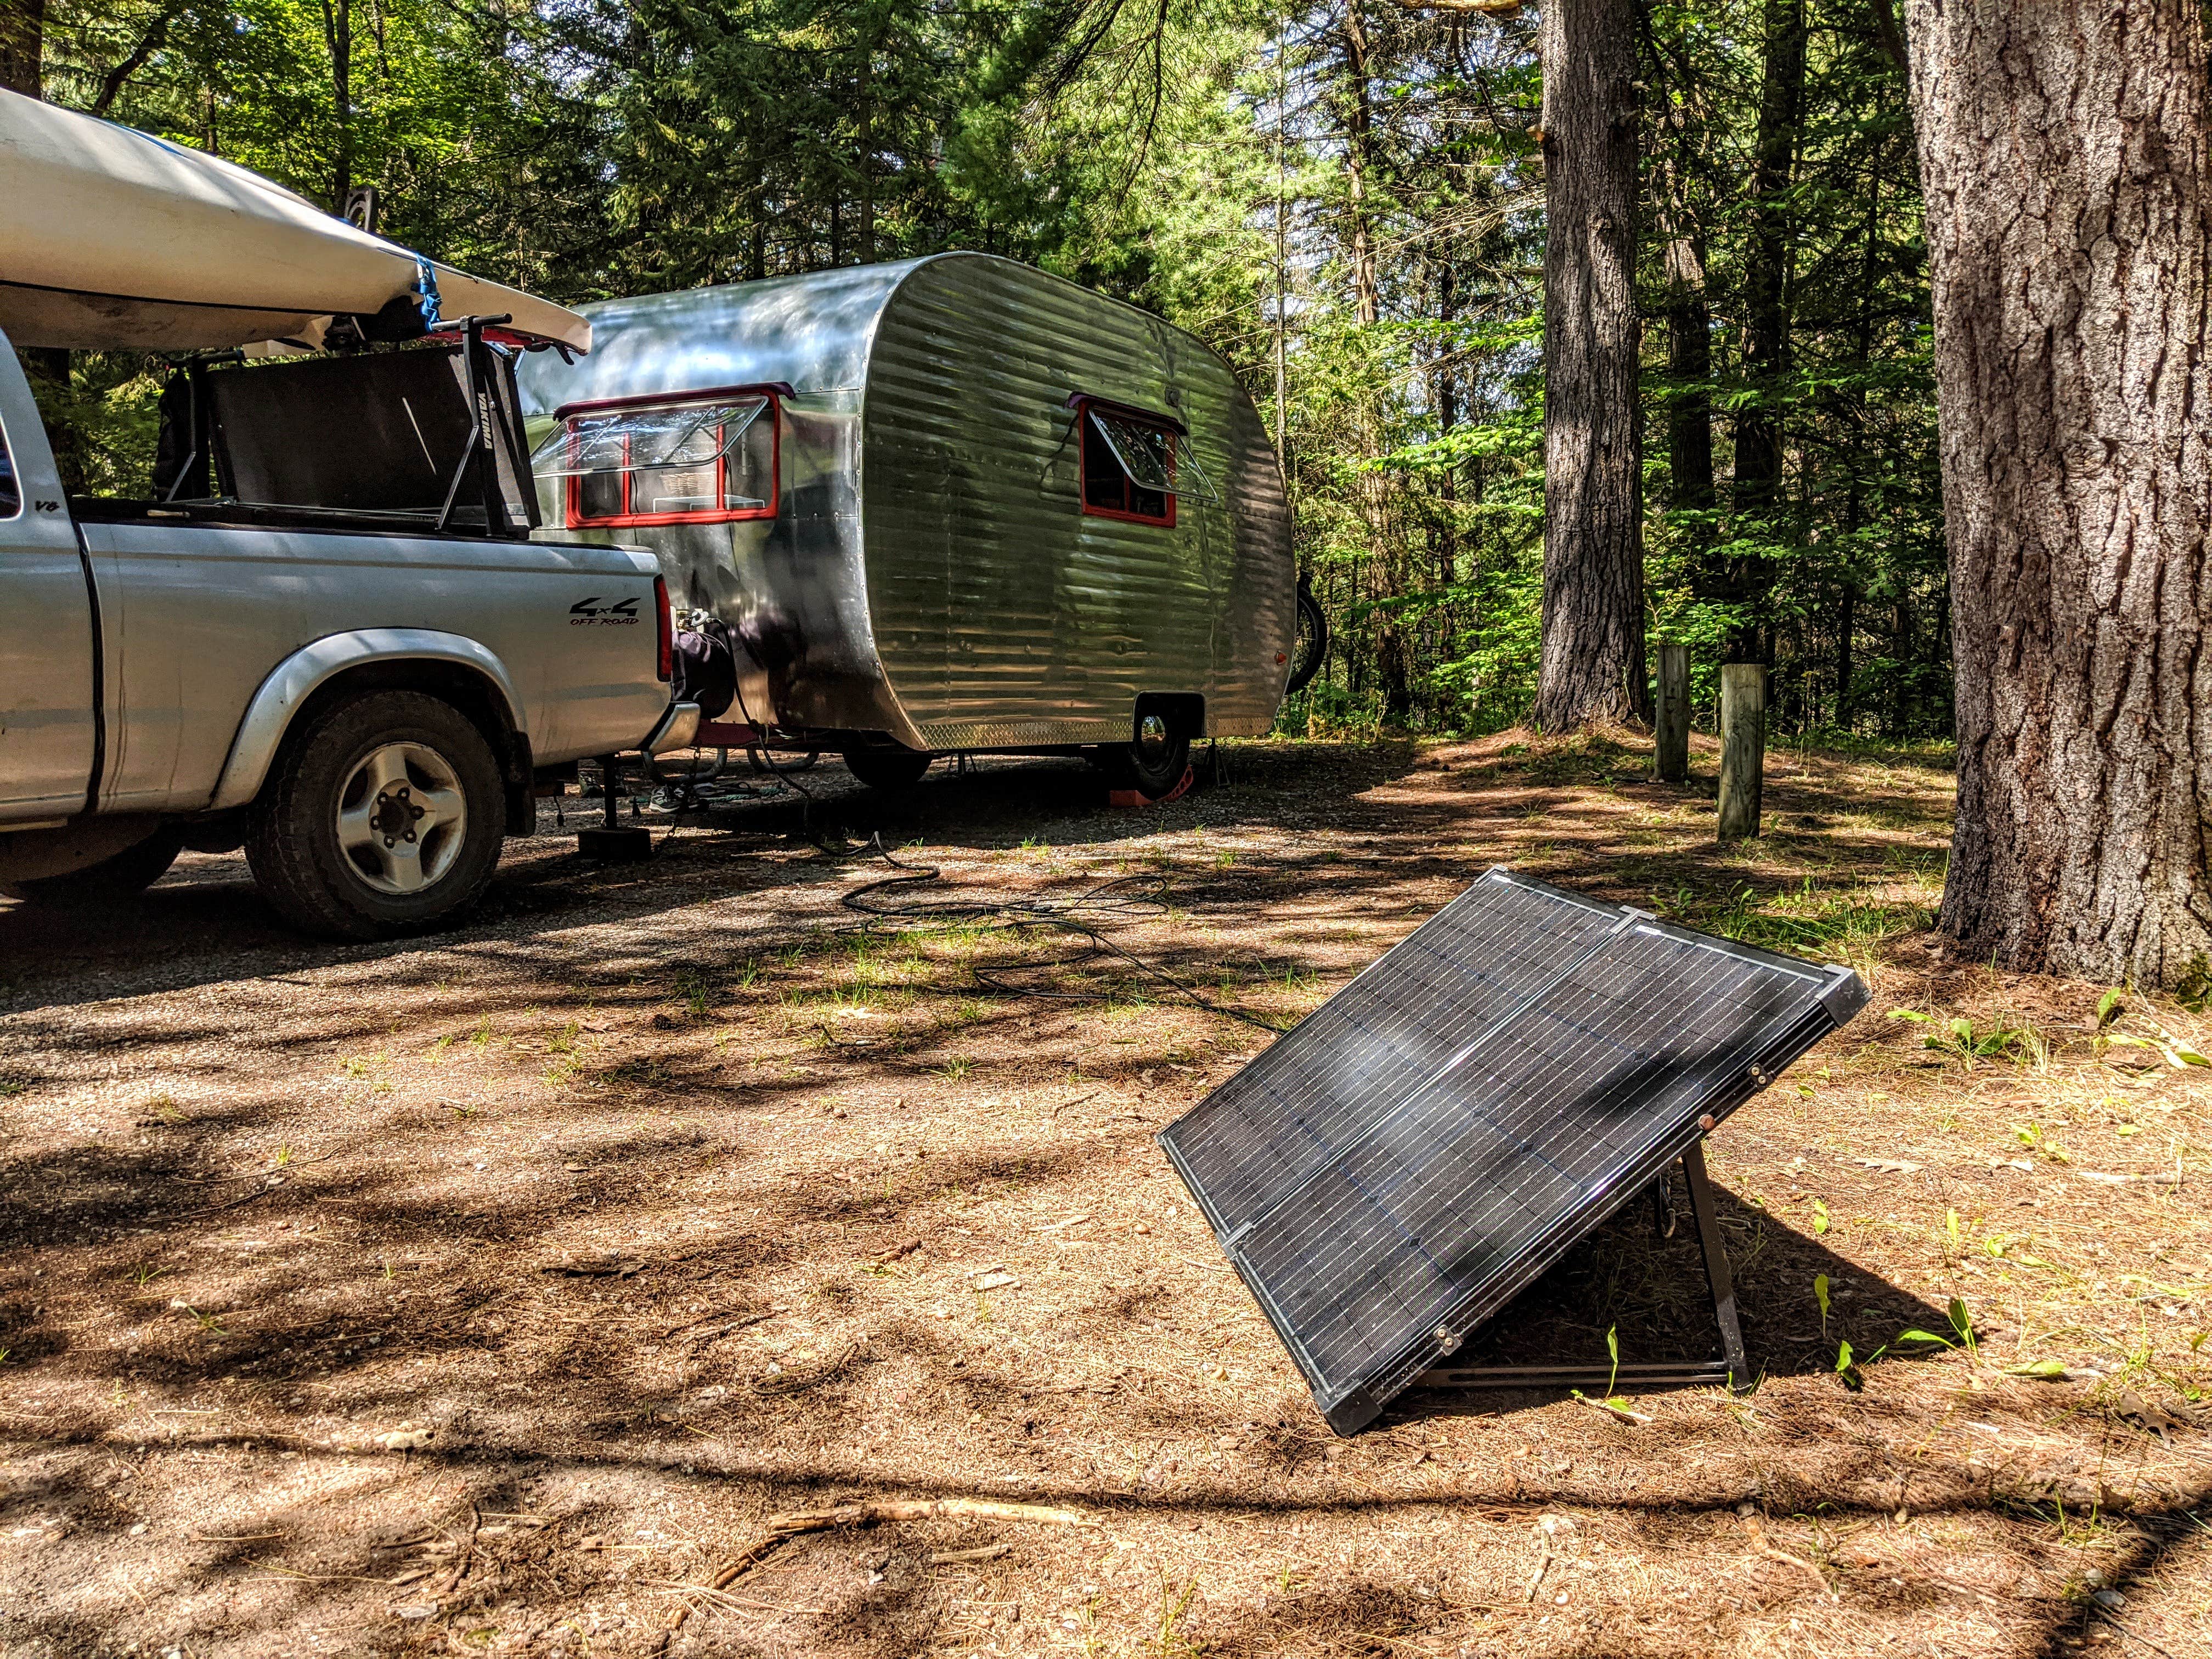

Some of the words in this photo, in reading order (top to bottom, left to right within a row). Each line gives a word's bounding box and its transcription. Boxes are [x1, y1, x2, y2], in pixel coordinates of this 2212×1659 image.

[478, 392, 492, 449] YAKIMA
[35, 500, 59, 512] V6
[569, 597, 641, 617] 4x4
